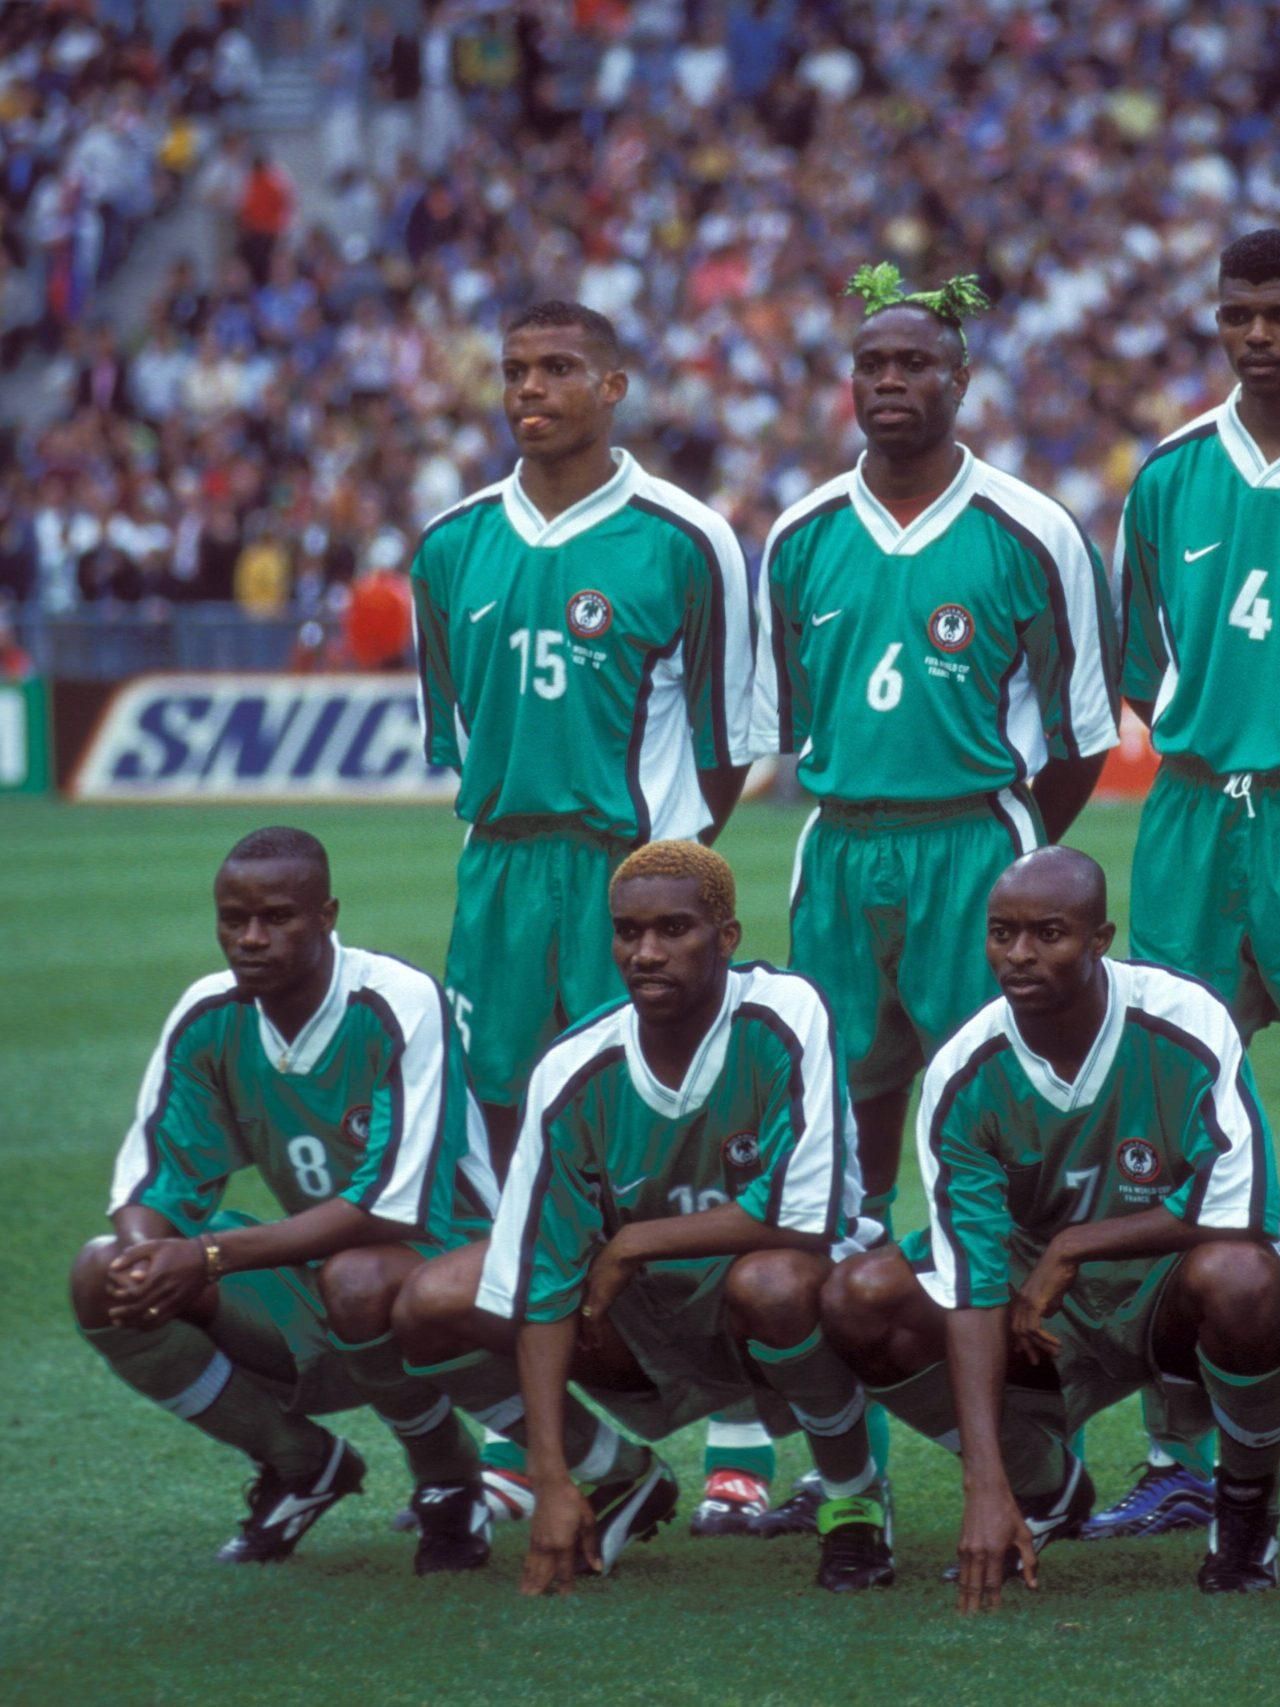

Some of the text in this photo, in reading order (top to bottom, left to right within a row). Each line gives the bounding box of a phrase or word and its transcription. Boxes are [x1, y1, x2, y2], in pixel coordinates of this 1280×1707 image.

[1228, 568, 1273, 641] 4
[509, 628, 567, 700] 15
[867, 641, 903, 712] 6
[112, 694, 448, 779] SNIC
[287, 1134, 333, 1198] 8
[1064, 1164, 1101, 1223] 7
